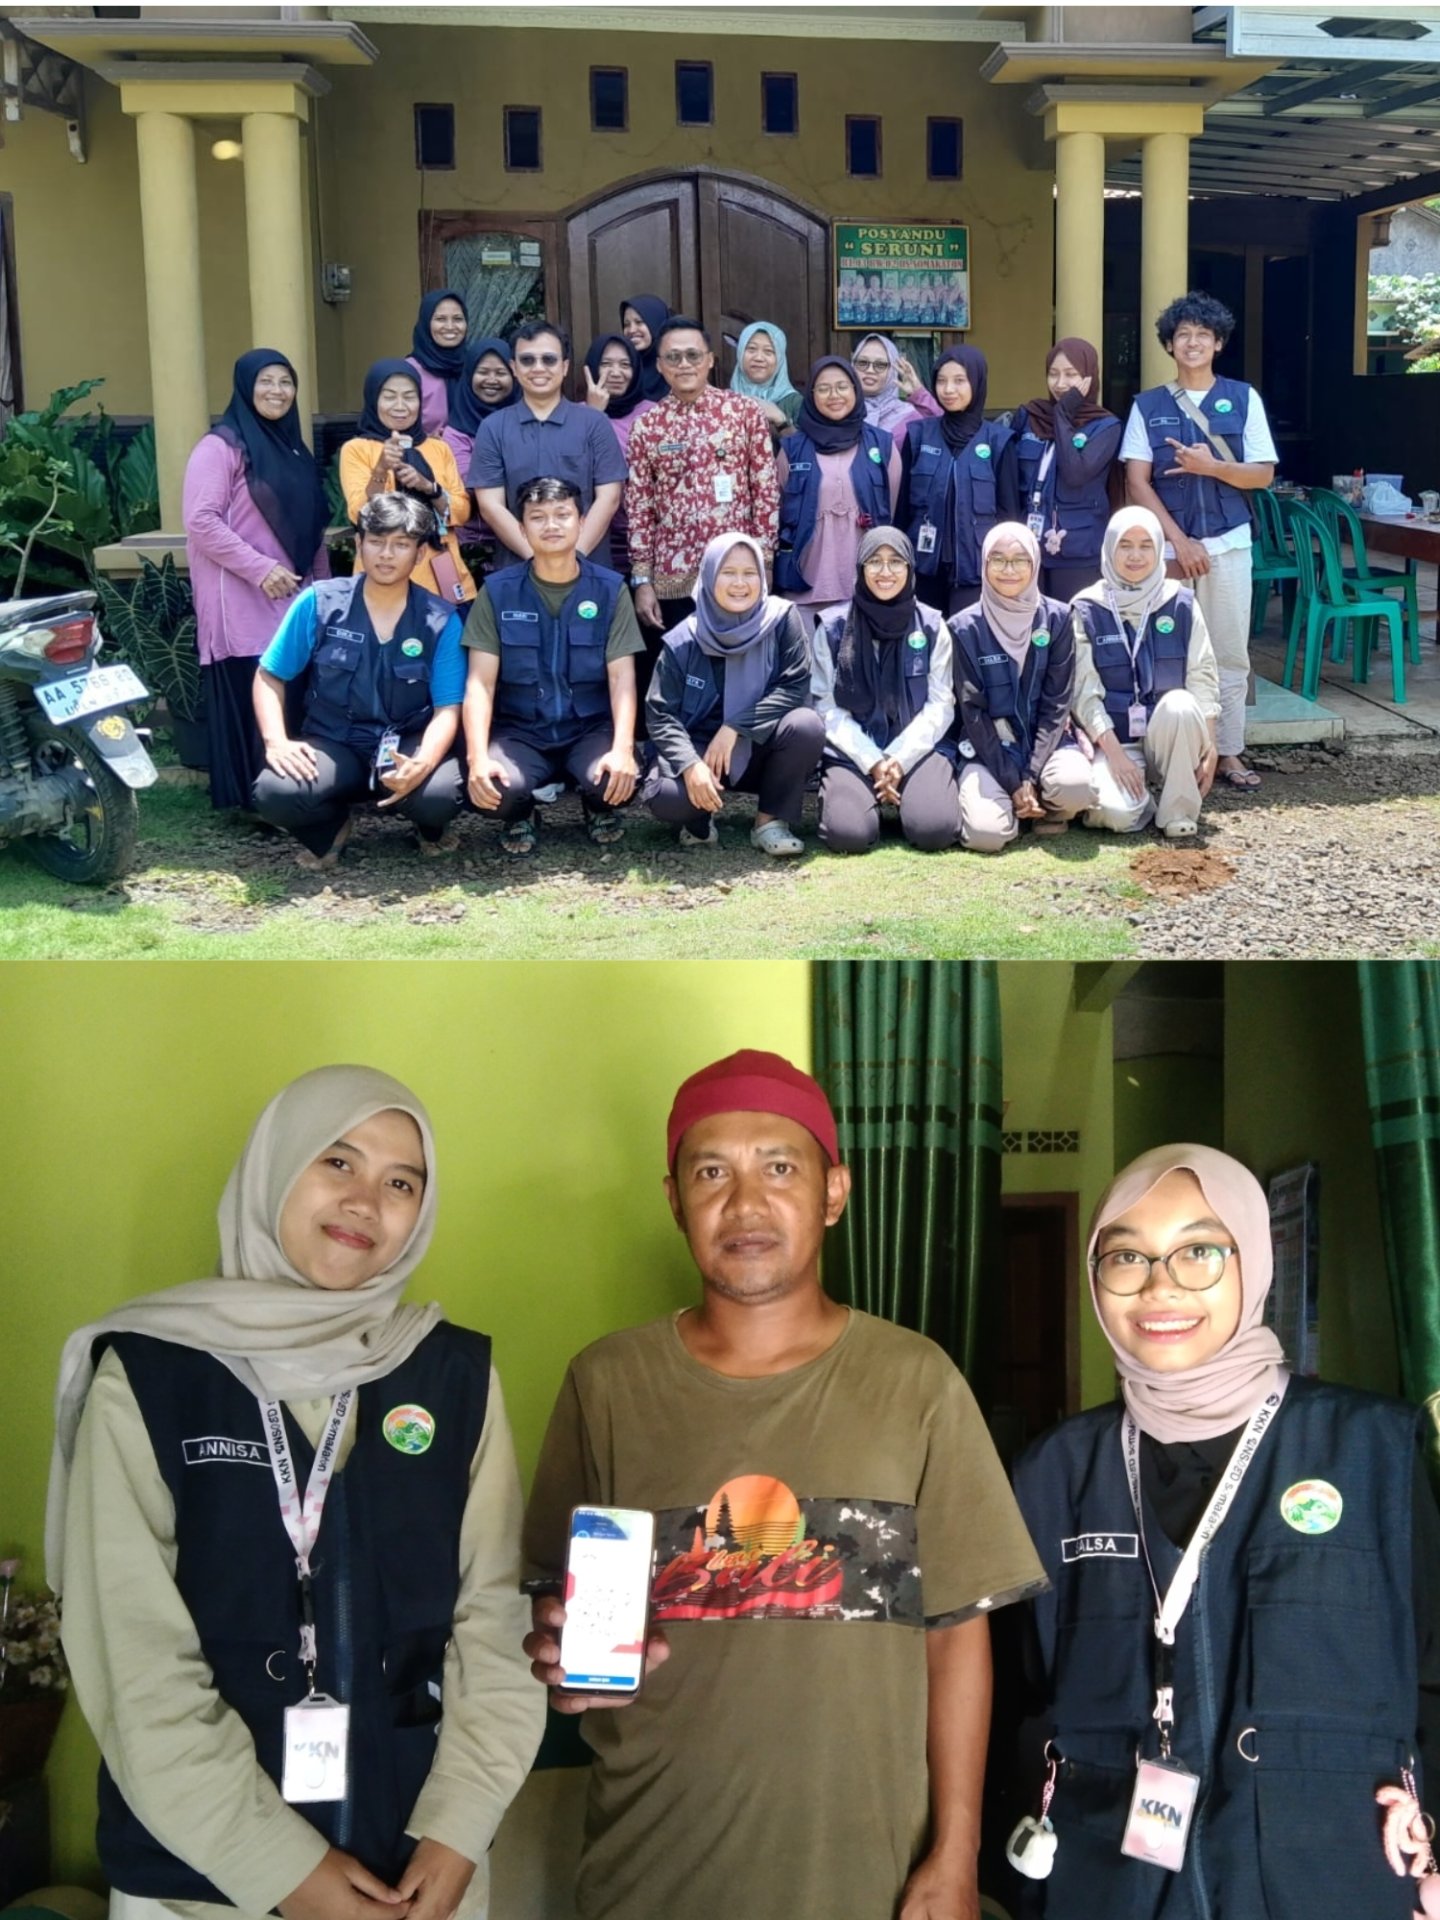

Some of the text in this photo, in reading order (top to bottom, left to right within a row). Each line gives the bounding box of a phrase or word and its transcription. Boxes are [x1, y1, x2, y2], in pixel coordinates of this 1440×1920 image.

[858, 228, 946, 240] POSYANDU
[43, 686, 66, 705] AA
[1252, 1409, 1271, 1433] KKN
[199, 1441, 261, 1460] ANNISA
[277, 1458, 291, 1485] KKN
[1141, 1799, 1183, 1828] KKN
